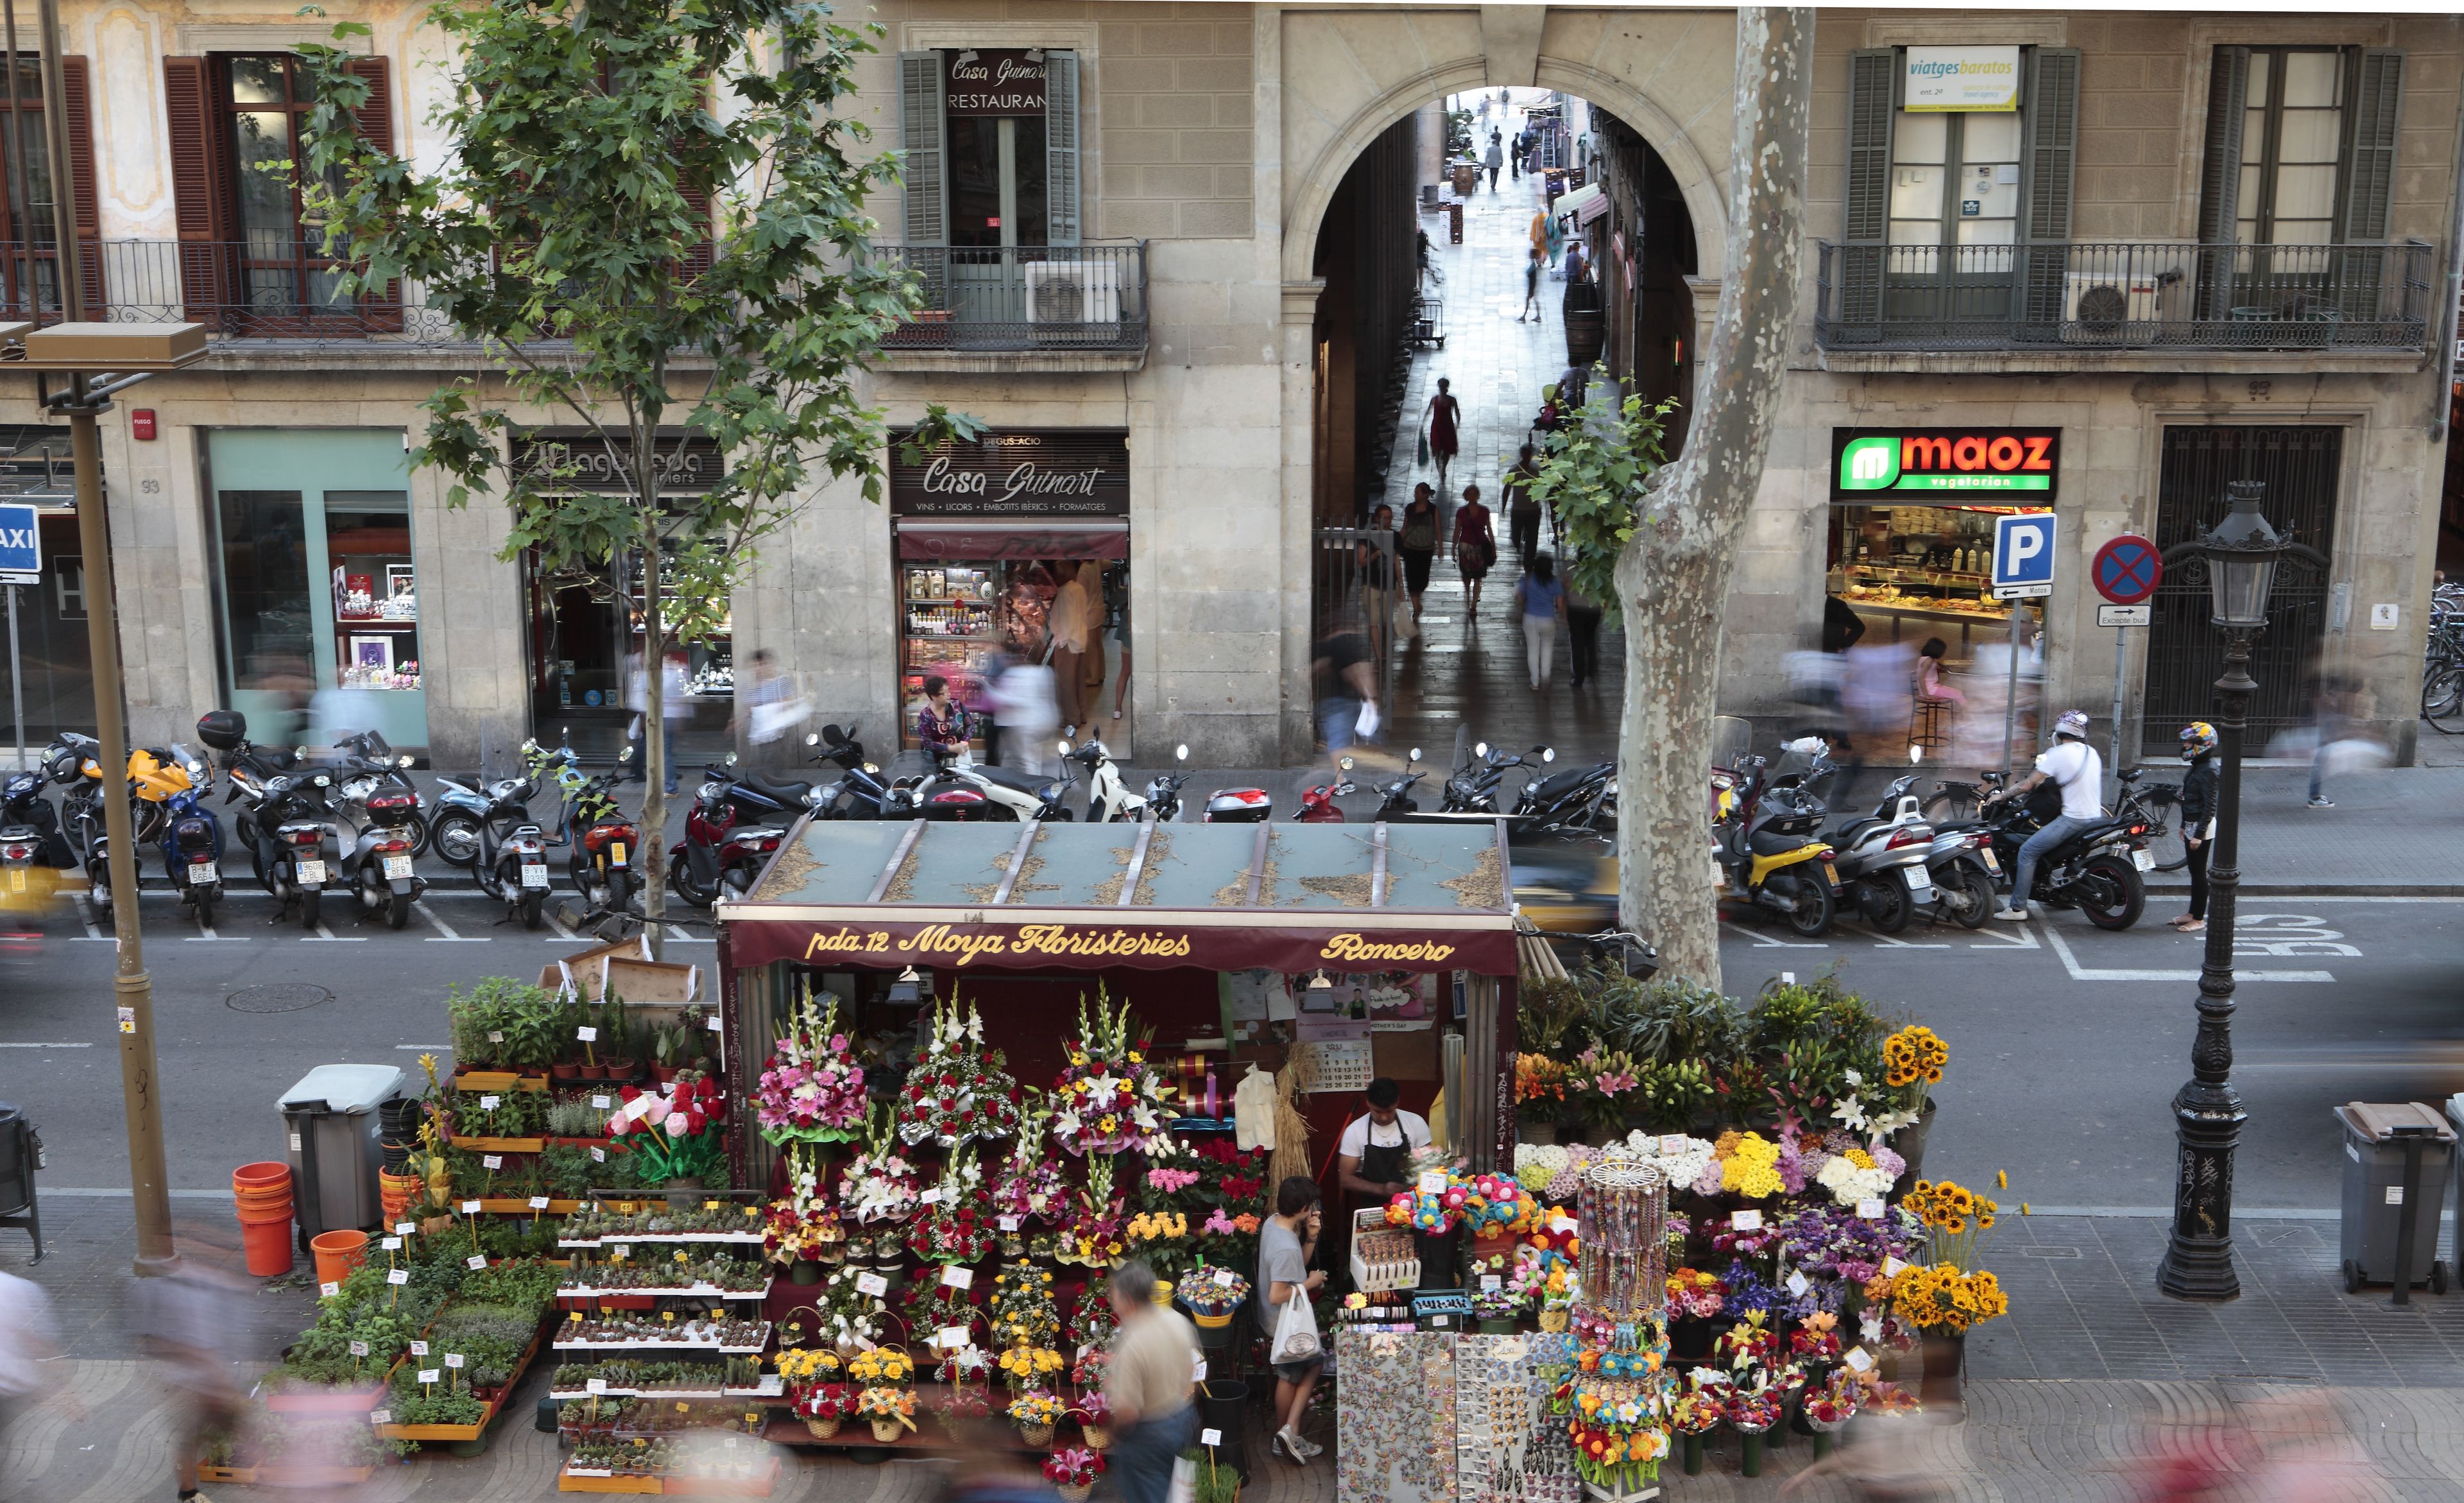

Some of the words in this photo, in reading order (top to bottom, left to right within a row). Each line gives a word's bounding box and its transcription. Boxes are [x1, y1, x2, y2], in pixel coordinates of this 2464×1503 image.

[952, 58, 988, 80] Casa
[1910, 60, 2012, 79] viatgesbaratos
[1902, 436, 2052, 470] maoz
[142, 479, 160, 494] 93
[923, 456, 986, 495] Casa
[993, 461, 1106, 502] Guinart
[1931, 476, 2010, 488] vegetarian
[2007, 525, 2044, 576] P
[390, 858, 410, 866] 3714
[391, 866, 406, 875] BFB
[193, 873, 213, 882] 5664
[898, 925, 1005, 965] Moya
[1011, 925, 1190, 957] Floristeries
[1320, 933, 1455, 961] Roncero
